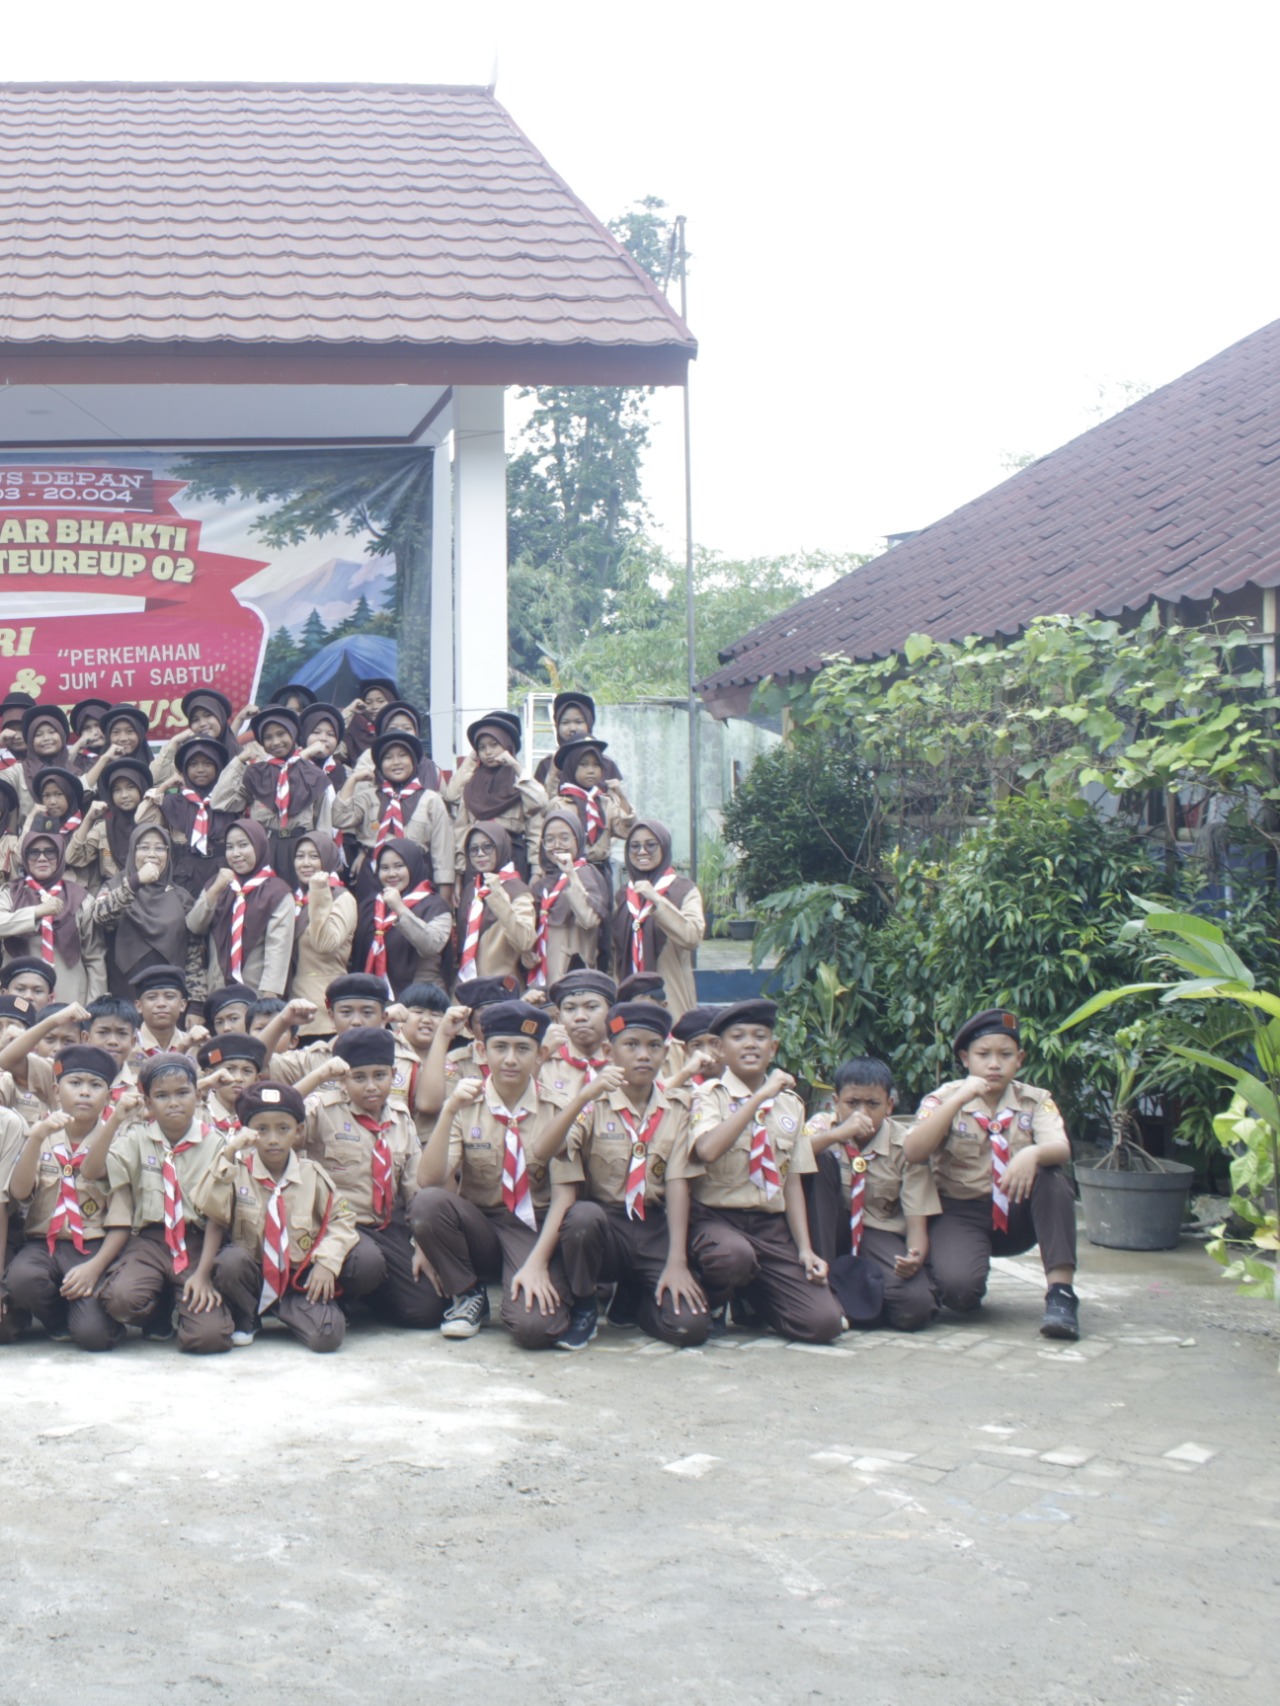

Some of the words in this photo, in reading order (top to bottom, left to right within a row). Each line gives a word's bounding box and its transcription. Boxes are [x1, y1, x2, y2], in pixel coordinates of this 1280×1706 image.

[32, 471, 144, 489] DEPAN
[43, 487, 133, 503] 20.004
[56, 518, 188, 552] BHAKTI
[151, 555, 195, 583] 02
[57, 643, 201, 667] "PERKEMAHAN
[9, 668, 46, 699] &
[58, 670, 136, 691] JUM'AT
[150, 664, 226, 686] SABTU"
